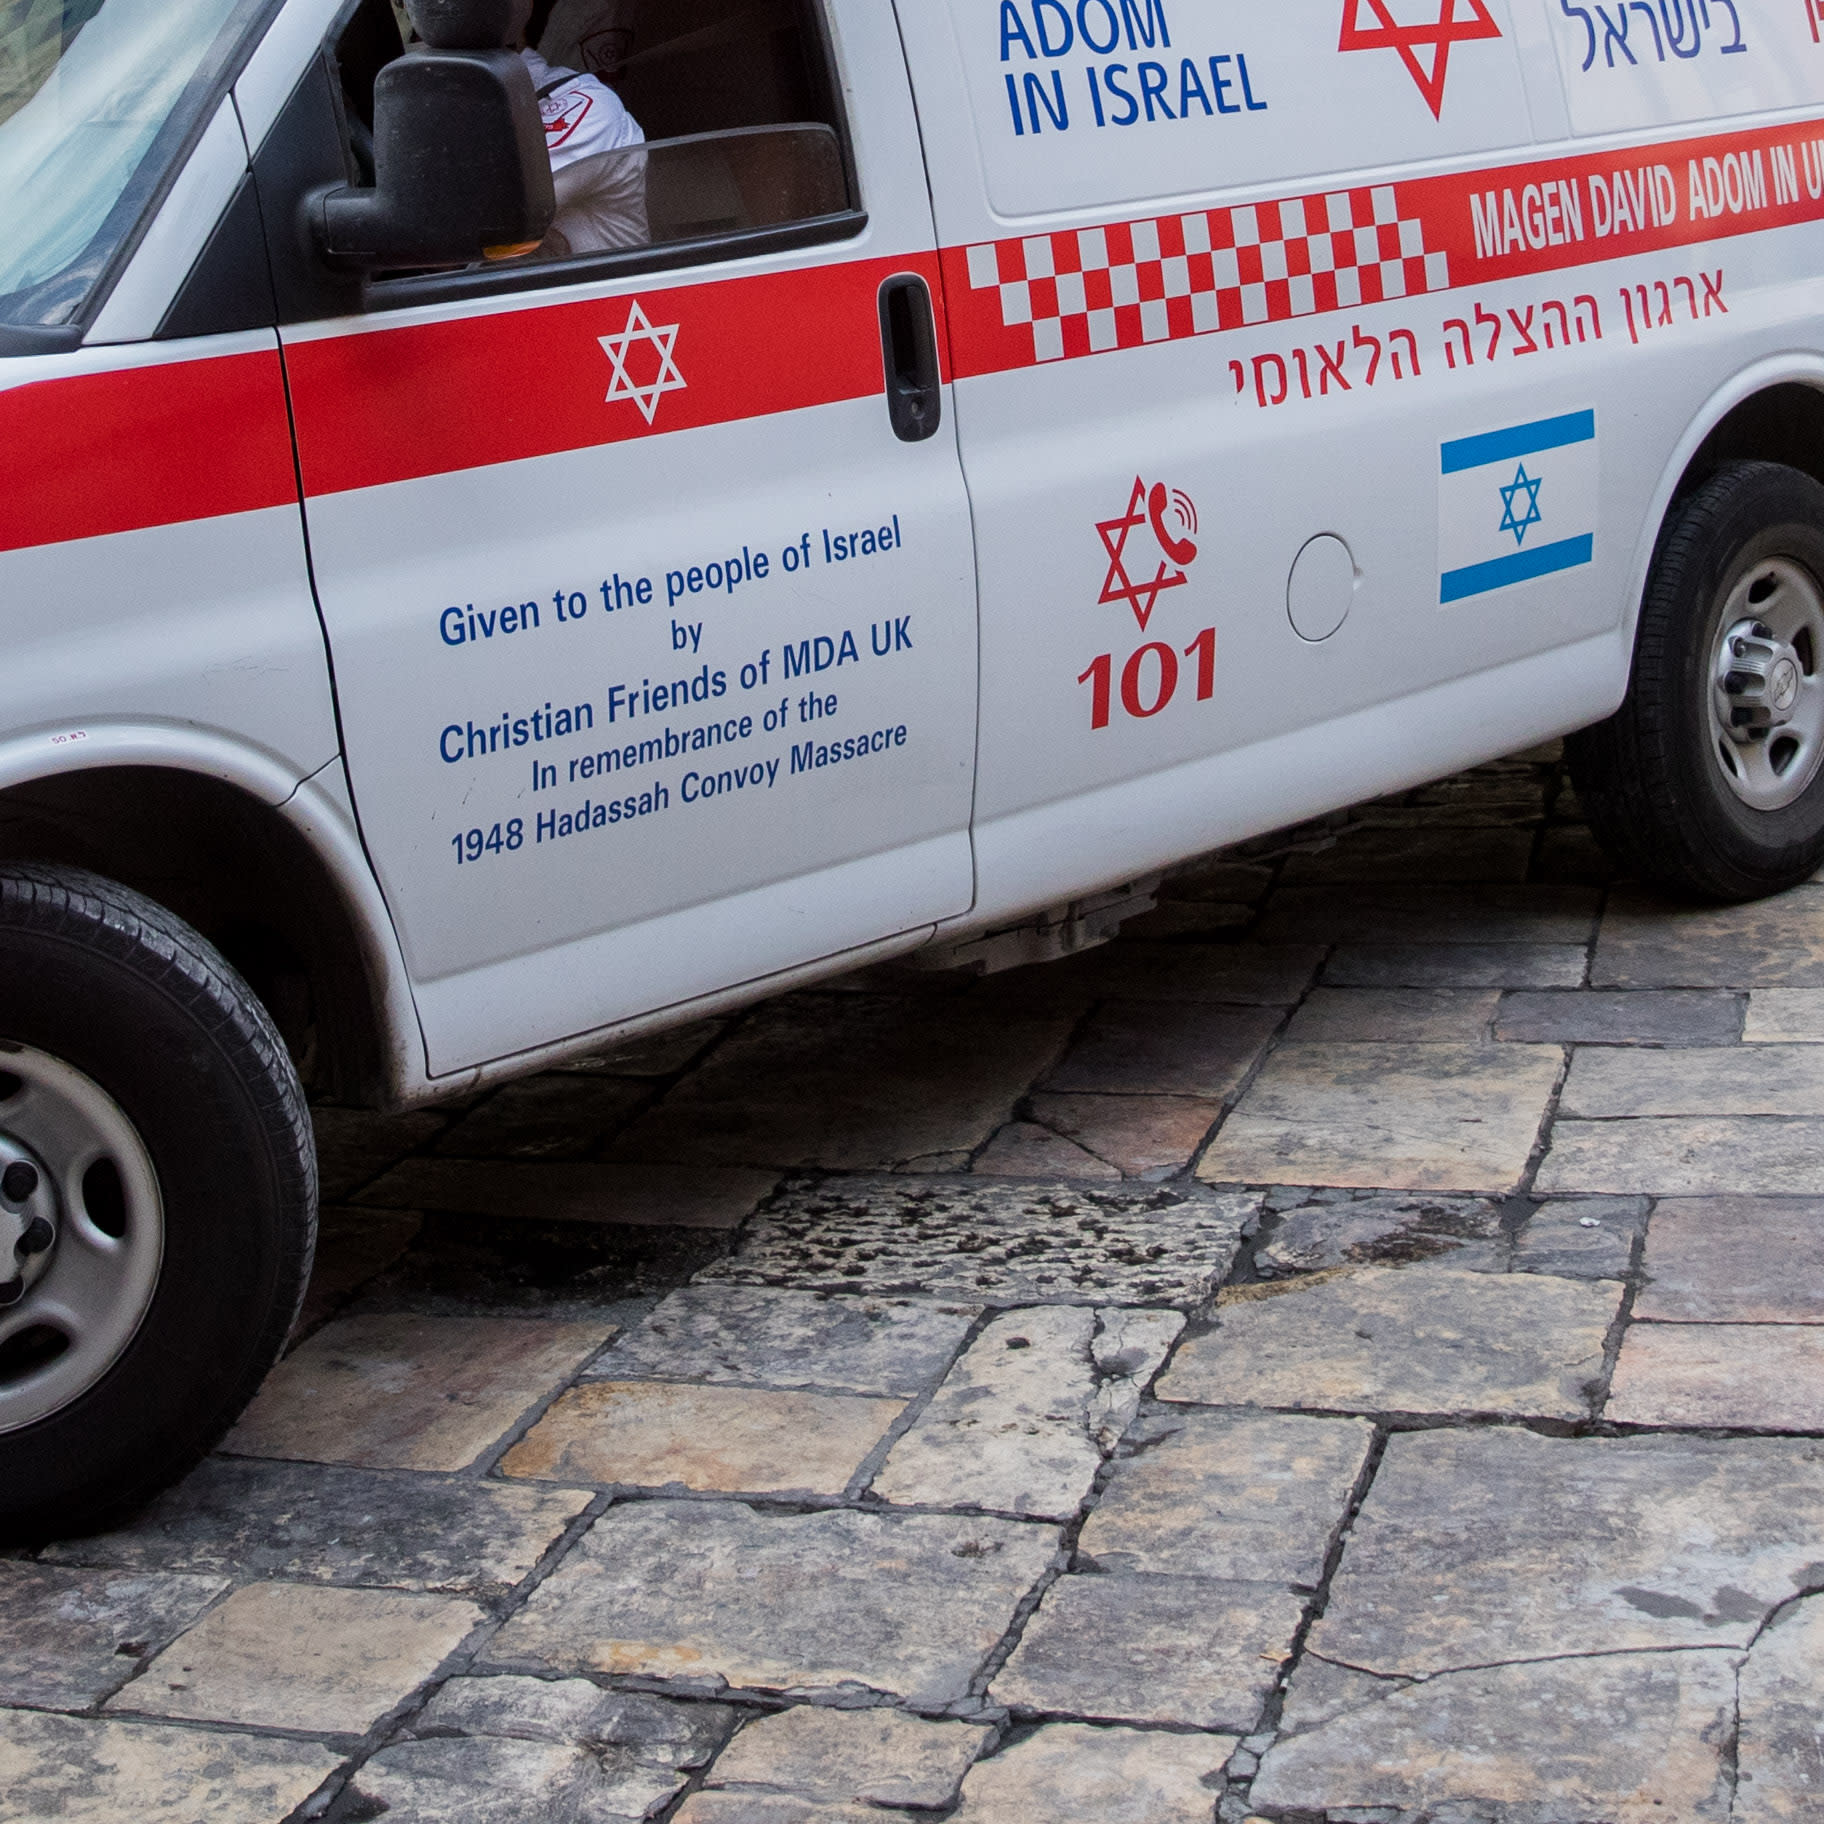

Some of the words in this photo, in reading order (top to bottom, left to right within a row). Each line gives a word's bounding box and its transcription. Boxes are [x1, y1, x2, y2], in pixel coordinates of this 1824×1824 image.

[1005, 69, 1069, 136] IN
[1087, 53, 1268, 127] ISRAEL
[1470, 179, 1585, 259] MAGEN
[1588, 164, 1676, 238] DAVID
[1688, 149, 1769, 221] ADOM
[1769, 144, 1801, 207] IN
[1443, 293, 1602, 369] ההצלה
[1619, 269, 1729, 344] ארגון
[1227, 324, 1421, 408] הלאומי
[439, 600, 540, 646] Given
[553, 588, 588, 623] to
[599, 573, 653, 613] the
[666, 546, 770, 606] people
[782, 532, 812, 572] of
[822, 514, 903, 564] Israel
[670, 619, 704, 653] by
[1077, 627, 1216, 730] 101
[439, 701, 594, 764] Christian
[607, 664, 727, 723] Friends
[740, 649, 771, 690] of
[783, 630, 860, 680] MDA
[871, 614, 914, 657] UK
[531, 760, 557, 792] In
[568, 713, 753, 783] remembrance
[763, 697, 788, 732] of
[798, 689, 838, 725] the
[451, 817, 524, 865] 1948
[536, 780, 669, 843] Hadassah
[680, 754, 780, 804] Convoy
[789, 721, 908, 776] Massacre
